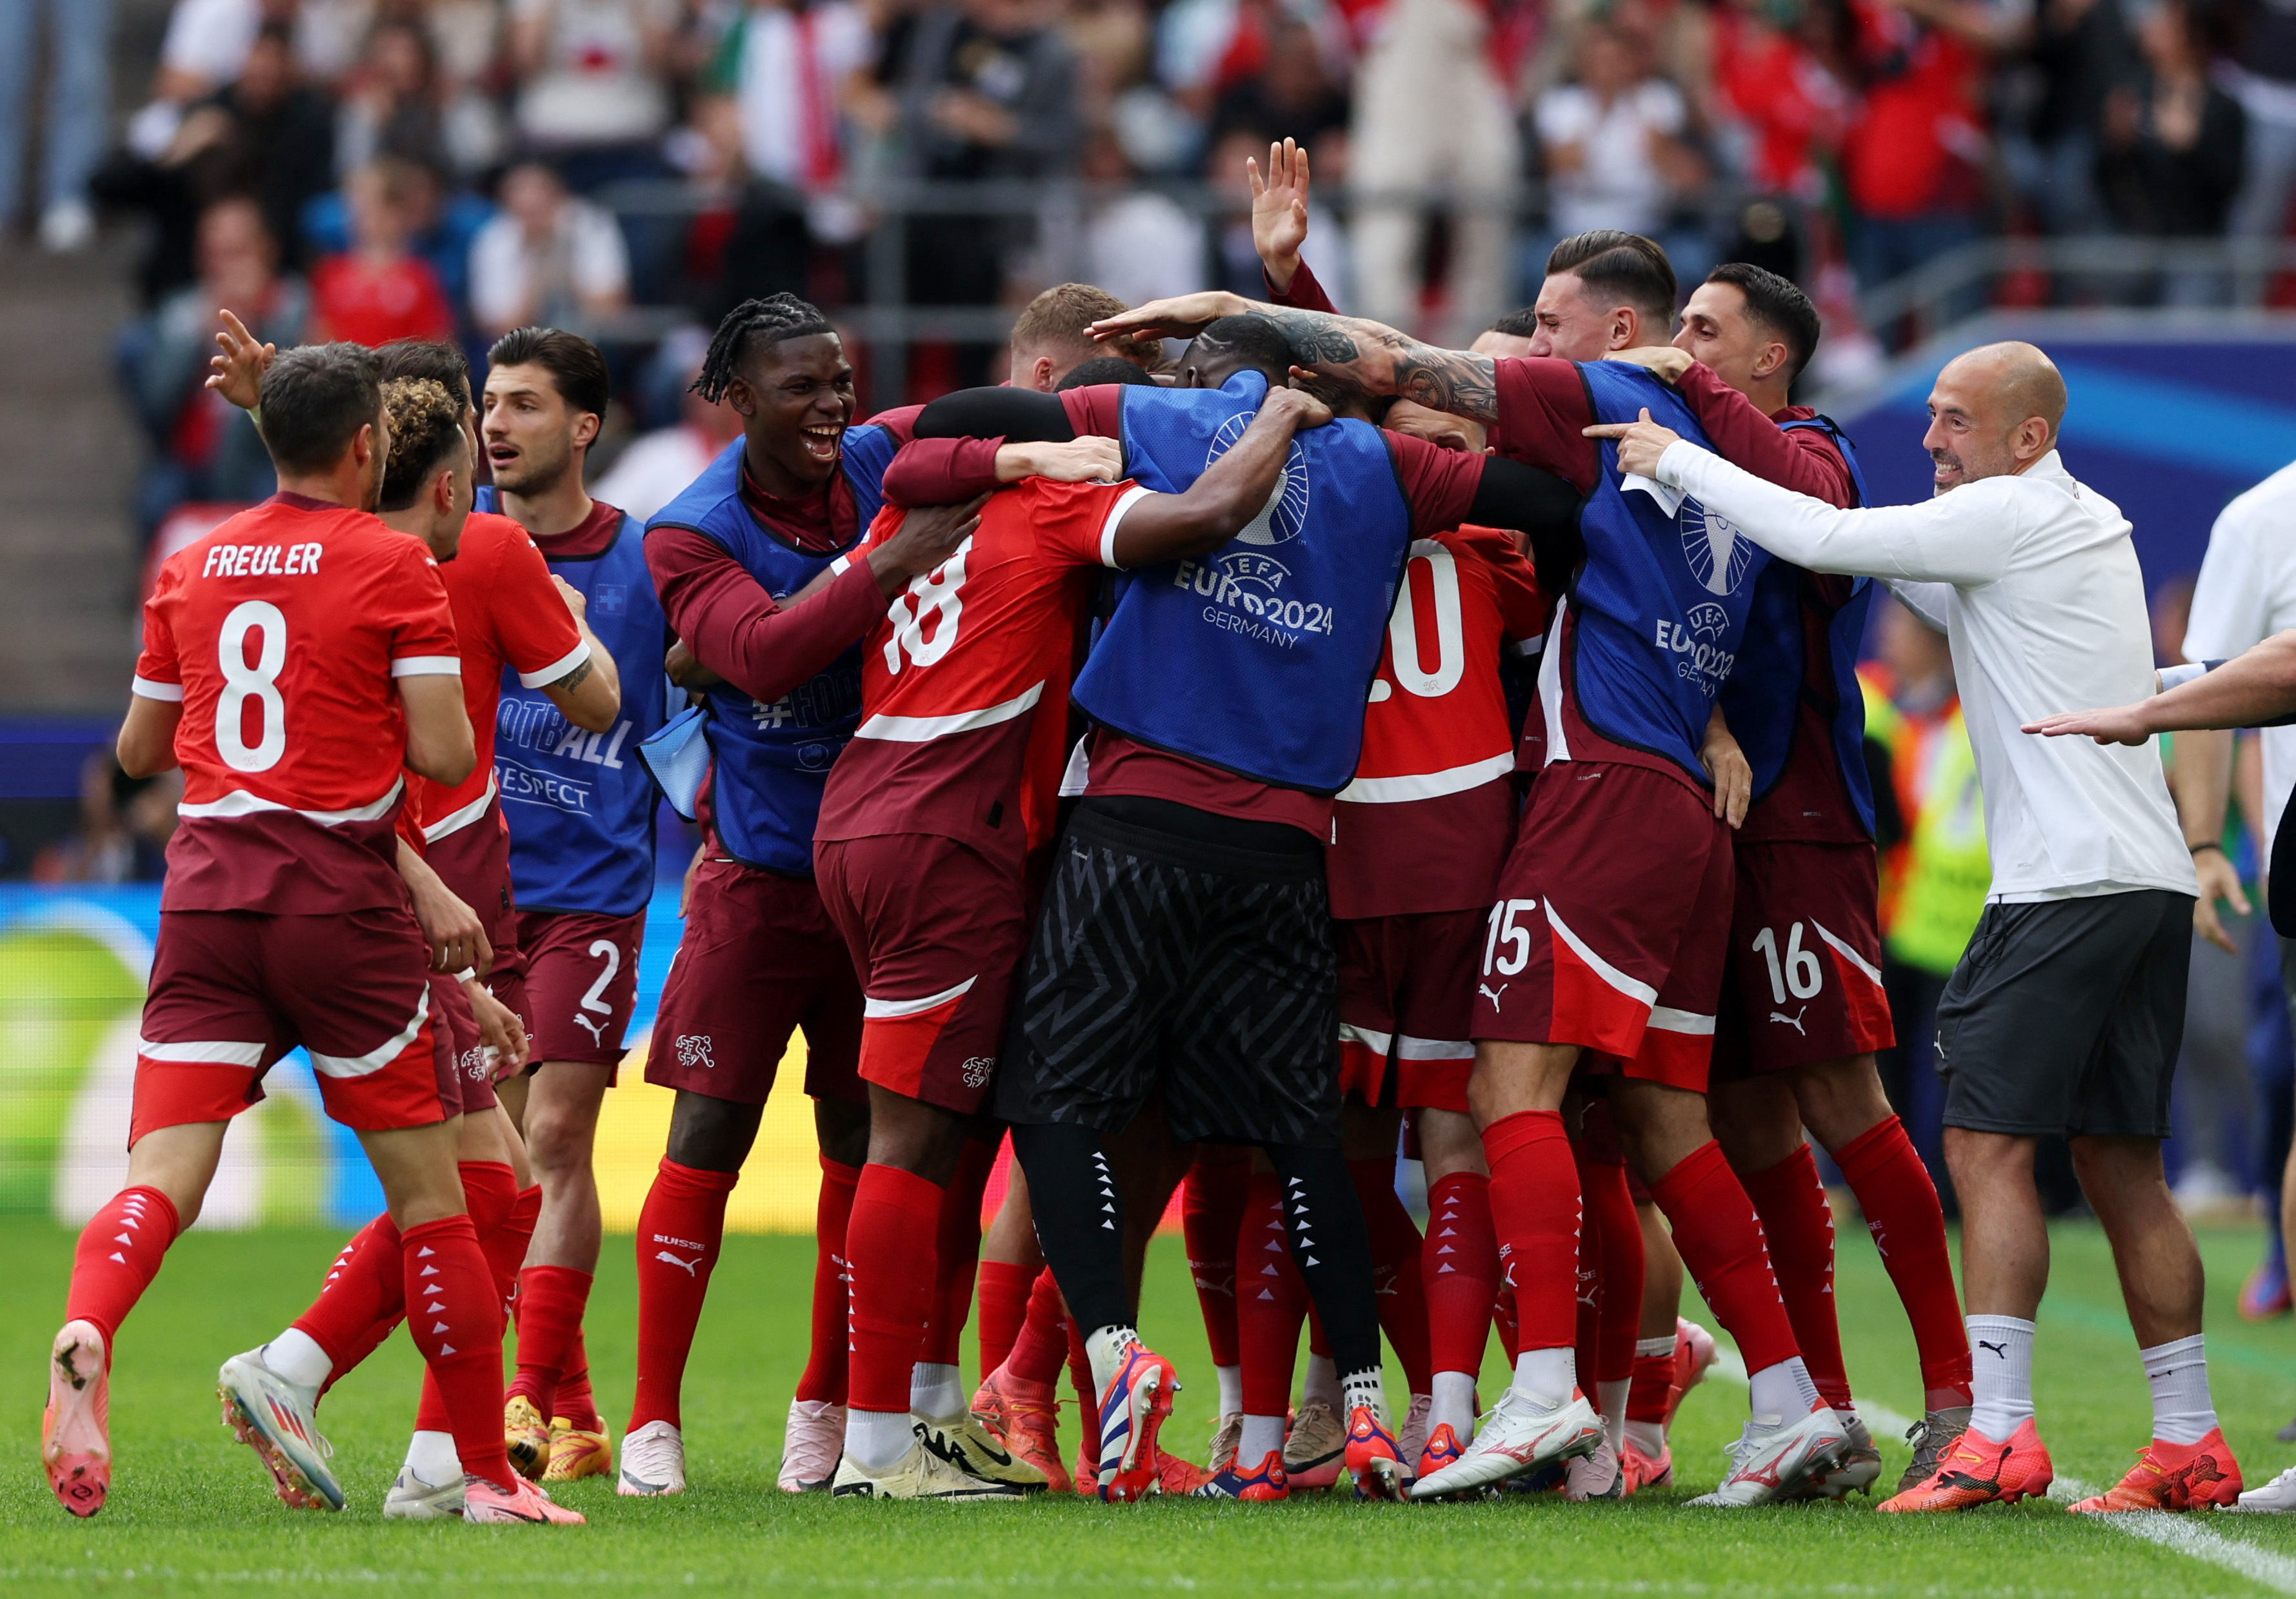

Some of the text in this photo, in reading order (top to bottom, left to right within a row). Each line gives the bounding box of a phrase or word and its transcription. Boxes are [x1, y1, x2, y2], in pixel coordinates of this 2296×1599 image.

[202, 542, 323, 579] FREULER
[883, 534, 973, 675] 18
[1202, 606, 1299, 650] GERMANY
[1689, 608, 1726, 639] UEFA
[215, 599, 286, 773] 8
[1483, 899, 1537, 976] 15
[1752, 921, 1822, 1004] 16
[580, 939, 620, 1015] 2
[653, 1233, 706, 1251] SUISSE
